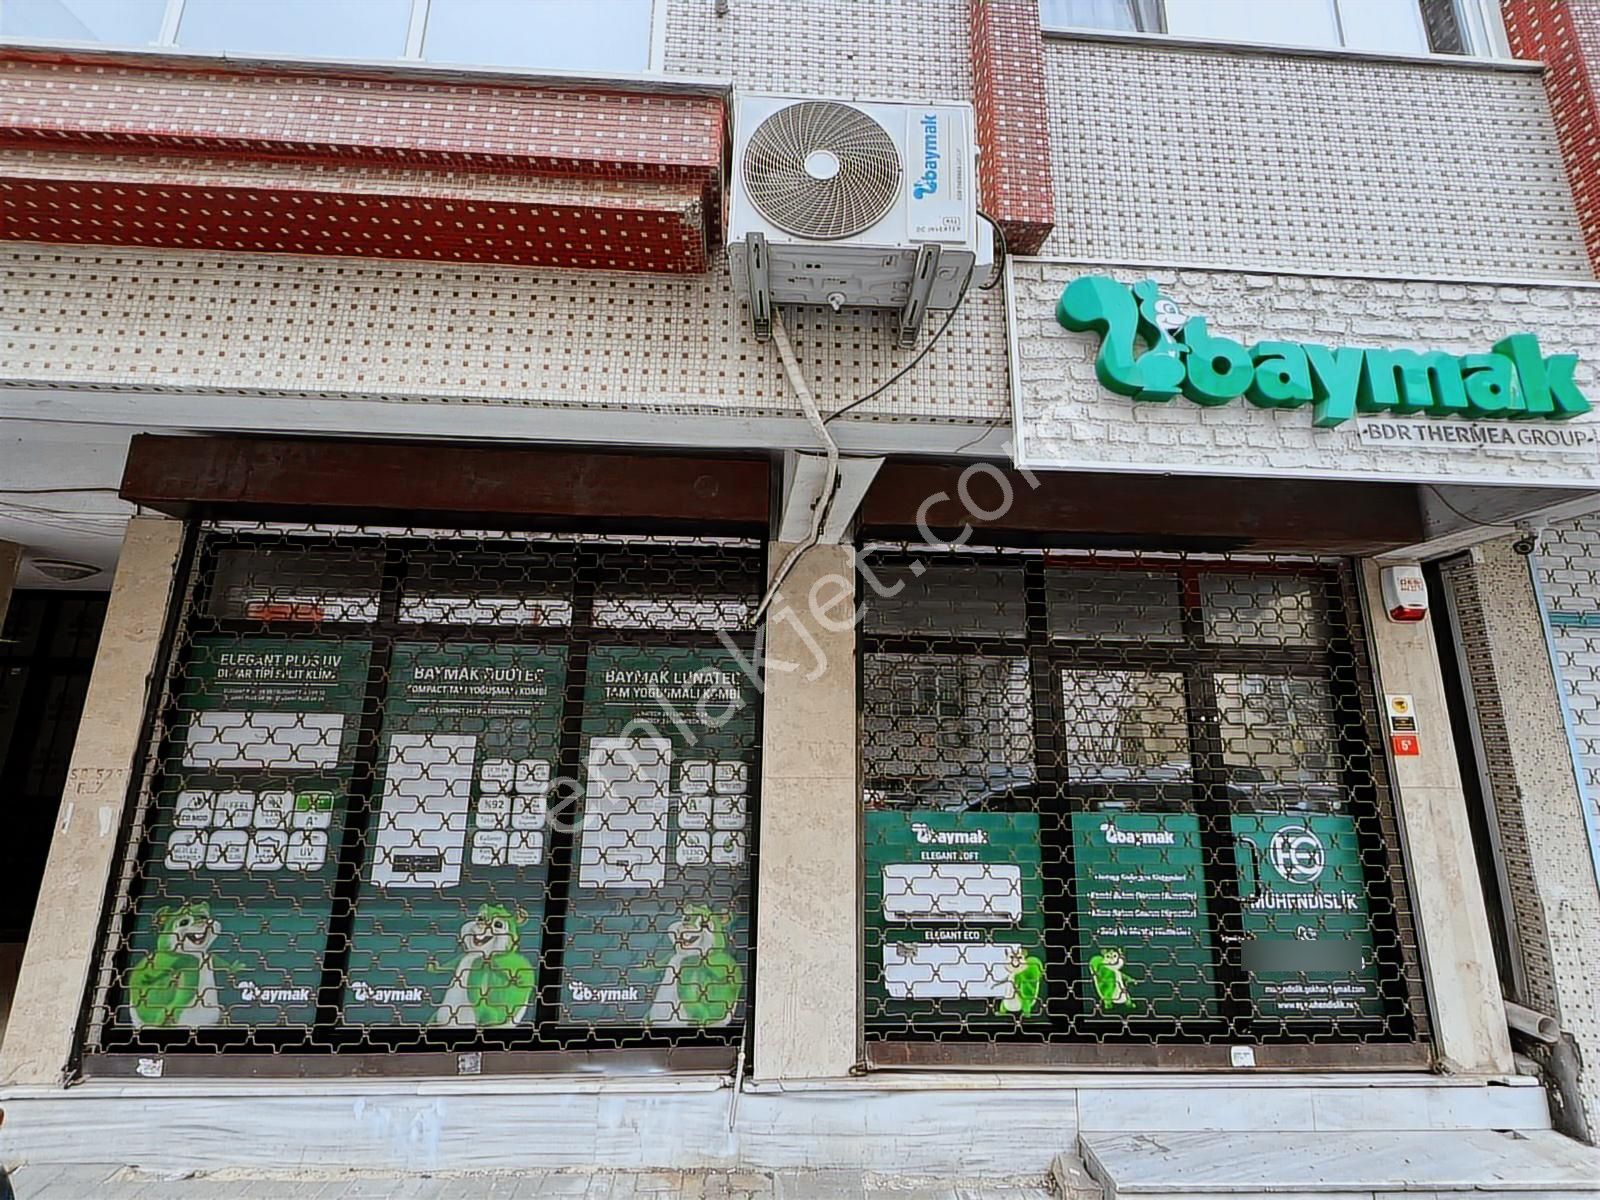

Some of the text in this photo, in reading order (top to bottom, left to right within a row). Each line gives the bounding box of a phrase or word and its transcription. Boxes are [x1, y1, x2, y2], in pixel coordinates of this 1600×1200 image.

[920, 113, 941, 181] baymak
[1182, 315, 1593, 428] baymak
[1367, 423, 1587, 447] BDR THERMEA GROUP
[220, 653, 283, 667] ELEGANT
[605, 670, 670, 685] BAYMAK
[406, 684, 449, 695] OMPACT
[920, 851, 979, 861] ELEGANT OFT
[924, 930, 980, 941] ELEGANT ECO
